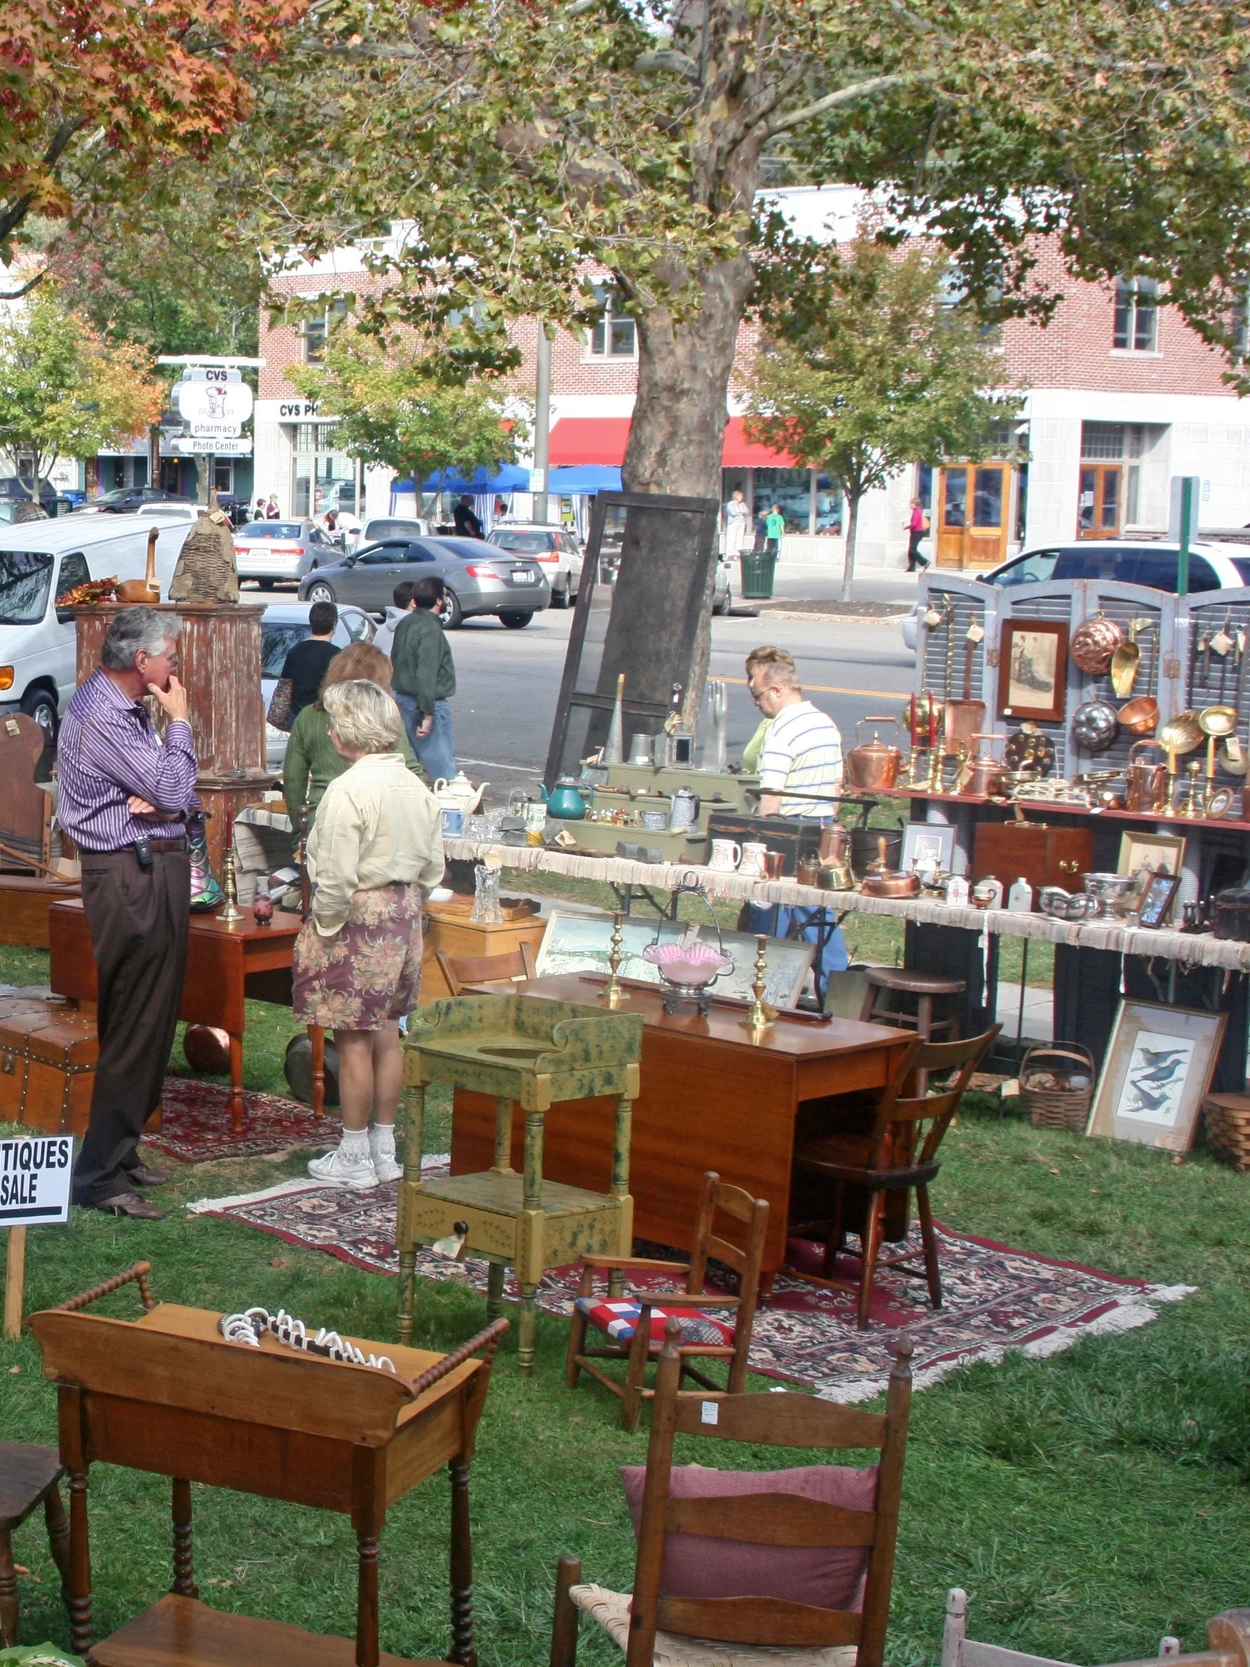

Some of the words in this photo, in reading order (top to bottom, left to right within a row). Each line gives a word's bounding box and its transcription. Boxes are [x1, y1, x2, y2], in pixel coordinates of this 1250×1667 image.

[206, 370, 227, 381] CVS
[280, 404, 300, 417] CVS
[195, 423, 237, 434] pharmacy
[193, 441, 213, 451] Photo
[215, 441, 239, 451] Center
[0, 1173, 38, 1206] SALE
